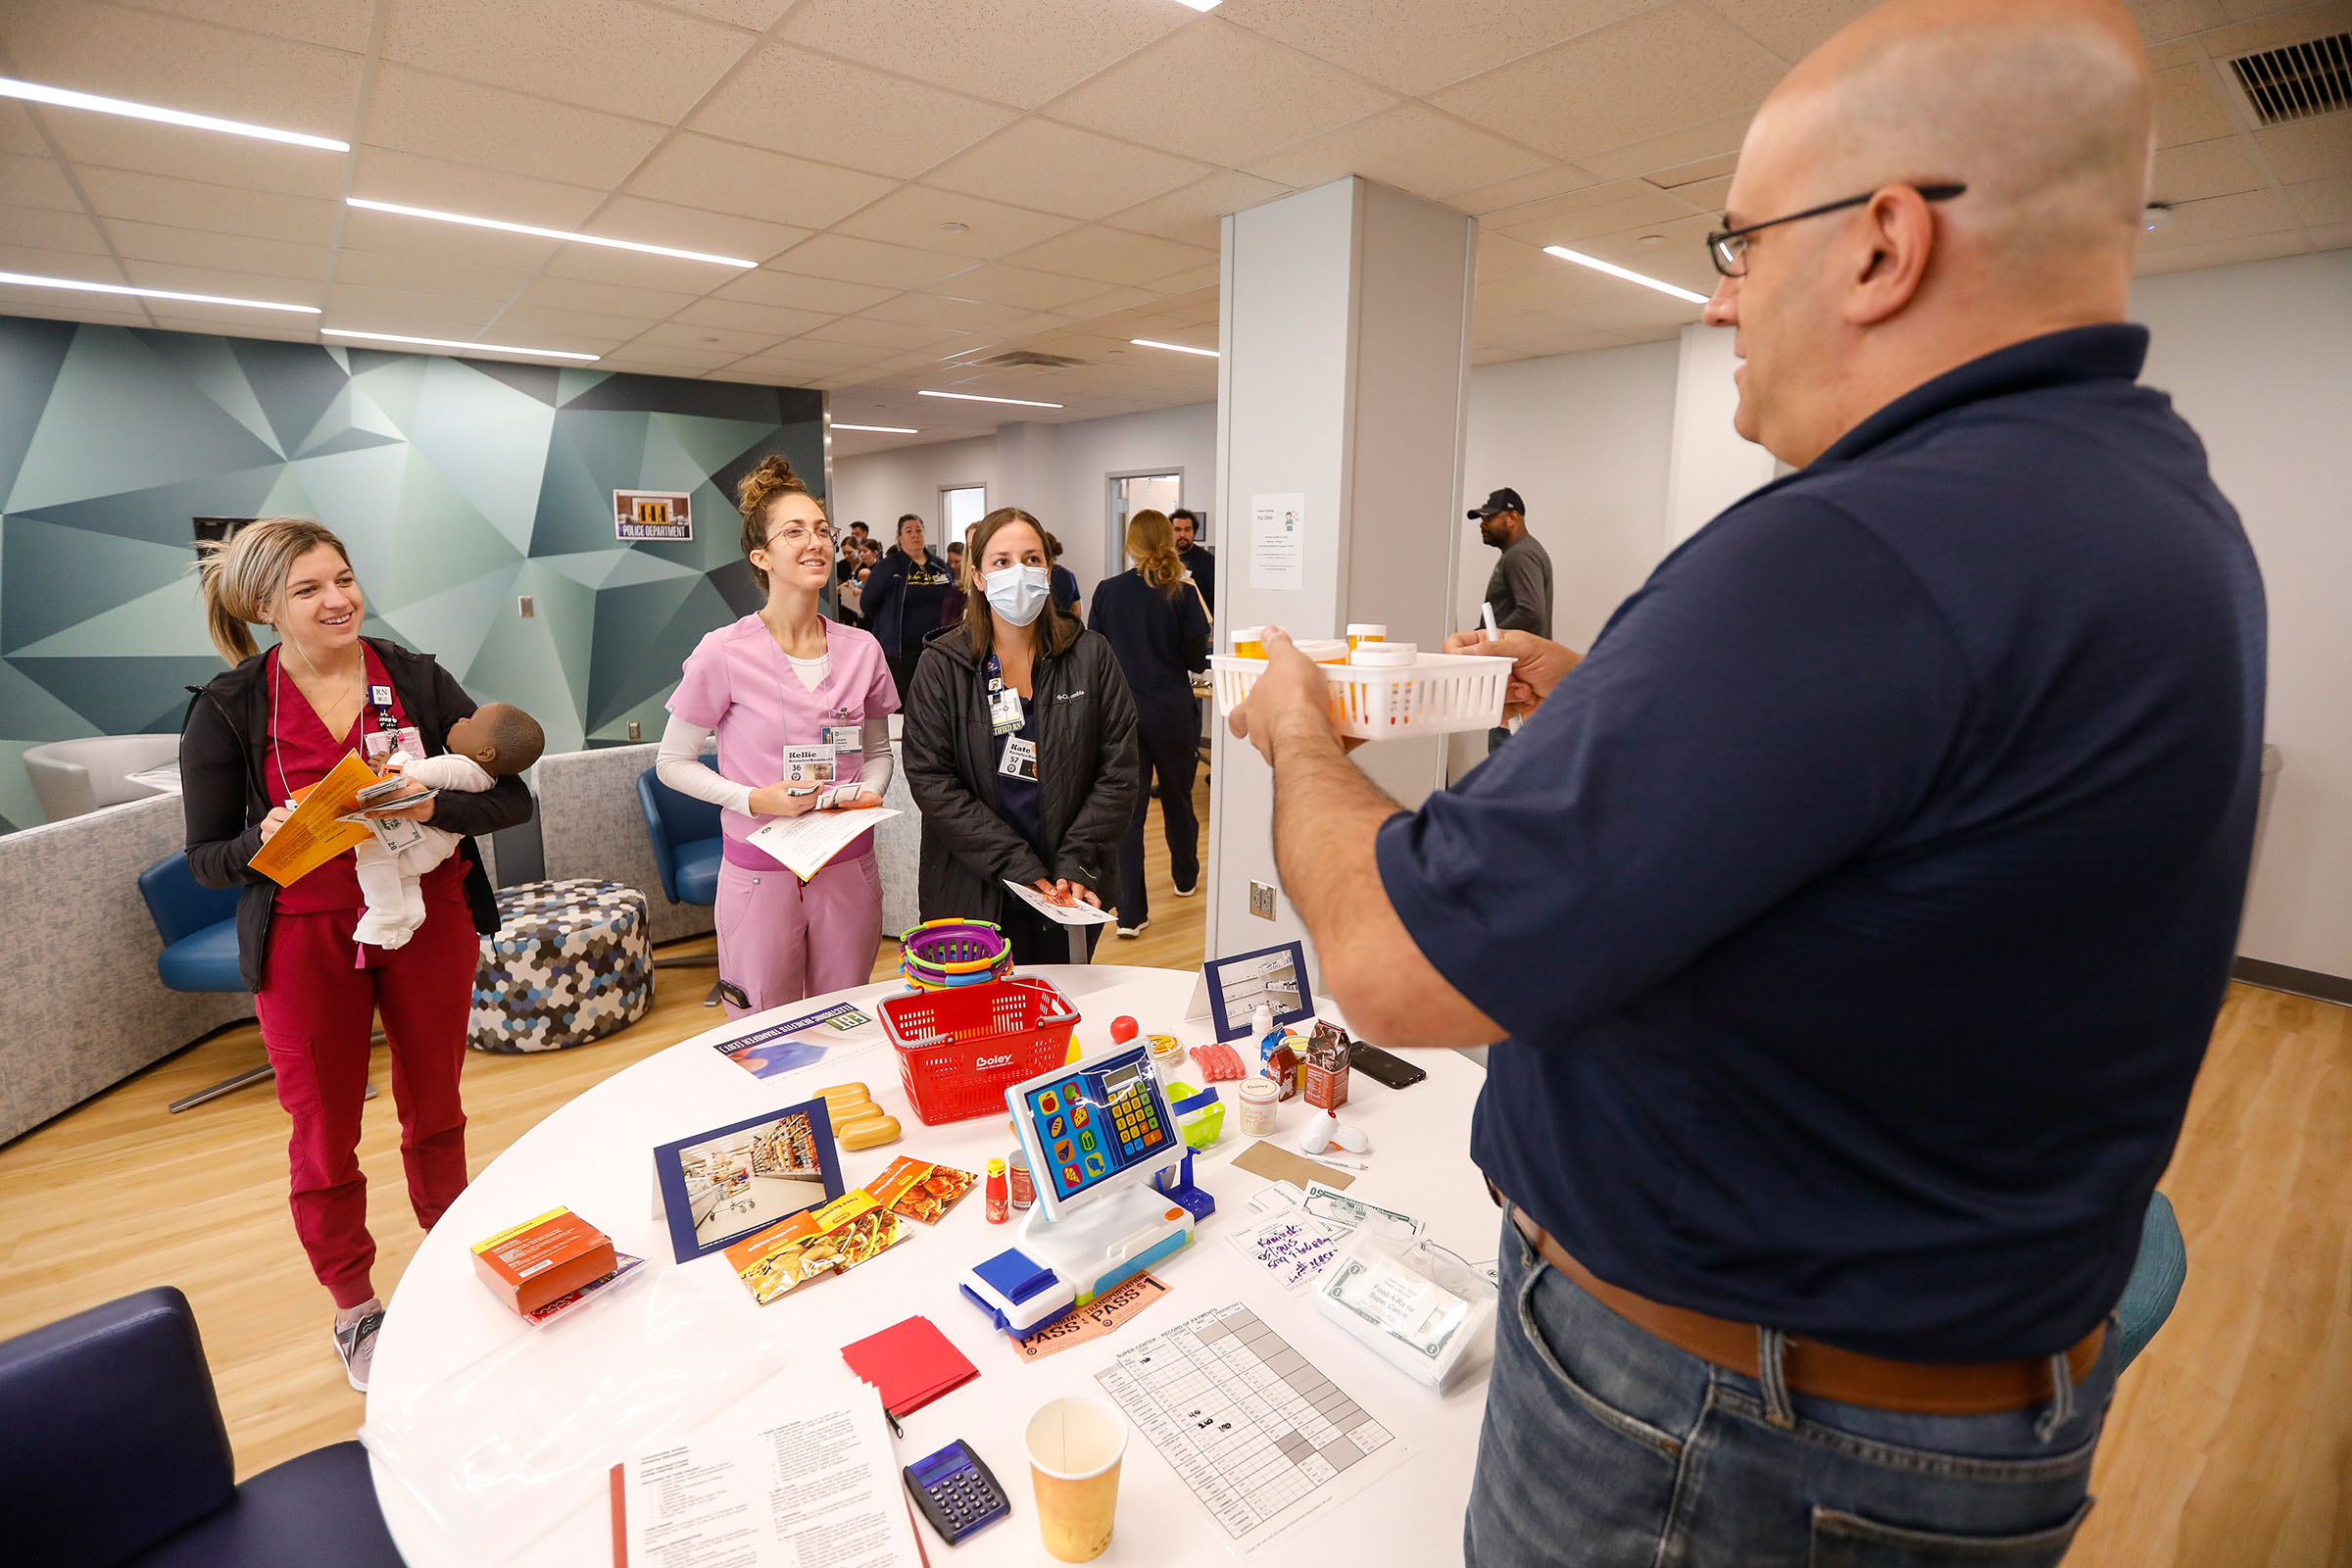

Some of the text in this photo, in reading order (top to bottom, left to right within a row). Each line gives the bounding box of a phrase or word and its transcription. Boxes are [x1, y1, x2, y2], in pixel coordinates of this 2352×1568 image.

[622, 524, 685, 537] POLICE DEPARTMENT
[1010, 744, 1031, 754] Kate
[387, 841, 398, 851] 20
[812, 1002, 855, 1023] ELECTRONIC
[832, 1012, 867, 1030] EBT
[782, 1016, 814, 1033] BENEFITS
[743, 1026, 781, 1046] TRANSFER
[976, 1054, 1012, 1067] Boley
[1309, 1187, 1324, 1197] 50
[1084, 1272, 1147, 1315] TRANSPORTATION
[1090, 1287, 1142, 1322] PASS
[1019, 1320, 1081, 1348] PASS
[1116, 1345, 1137, 1358] SUPER
[1135, 1335, 1157, 1351] CENTER
[1160, 1323, 1184, 1337] RECORD
[1190, 1307, 1218, 1325] PAYMENTS
